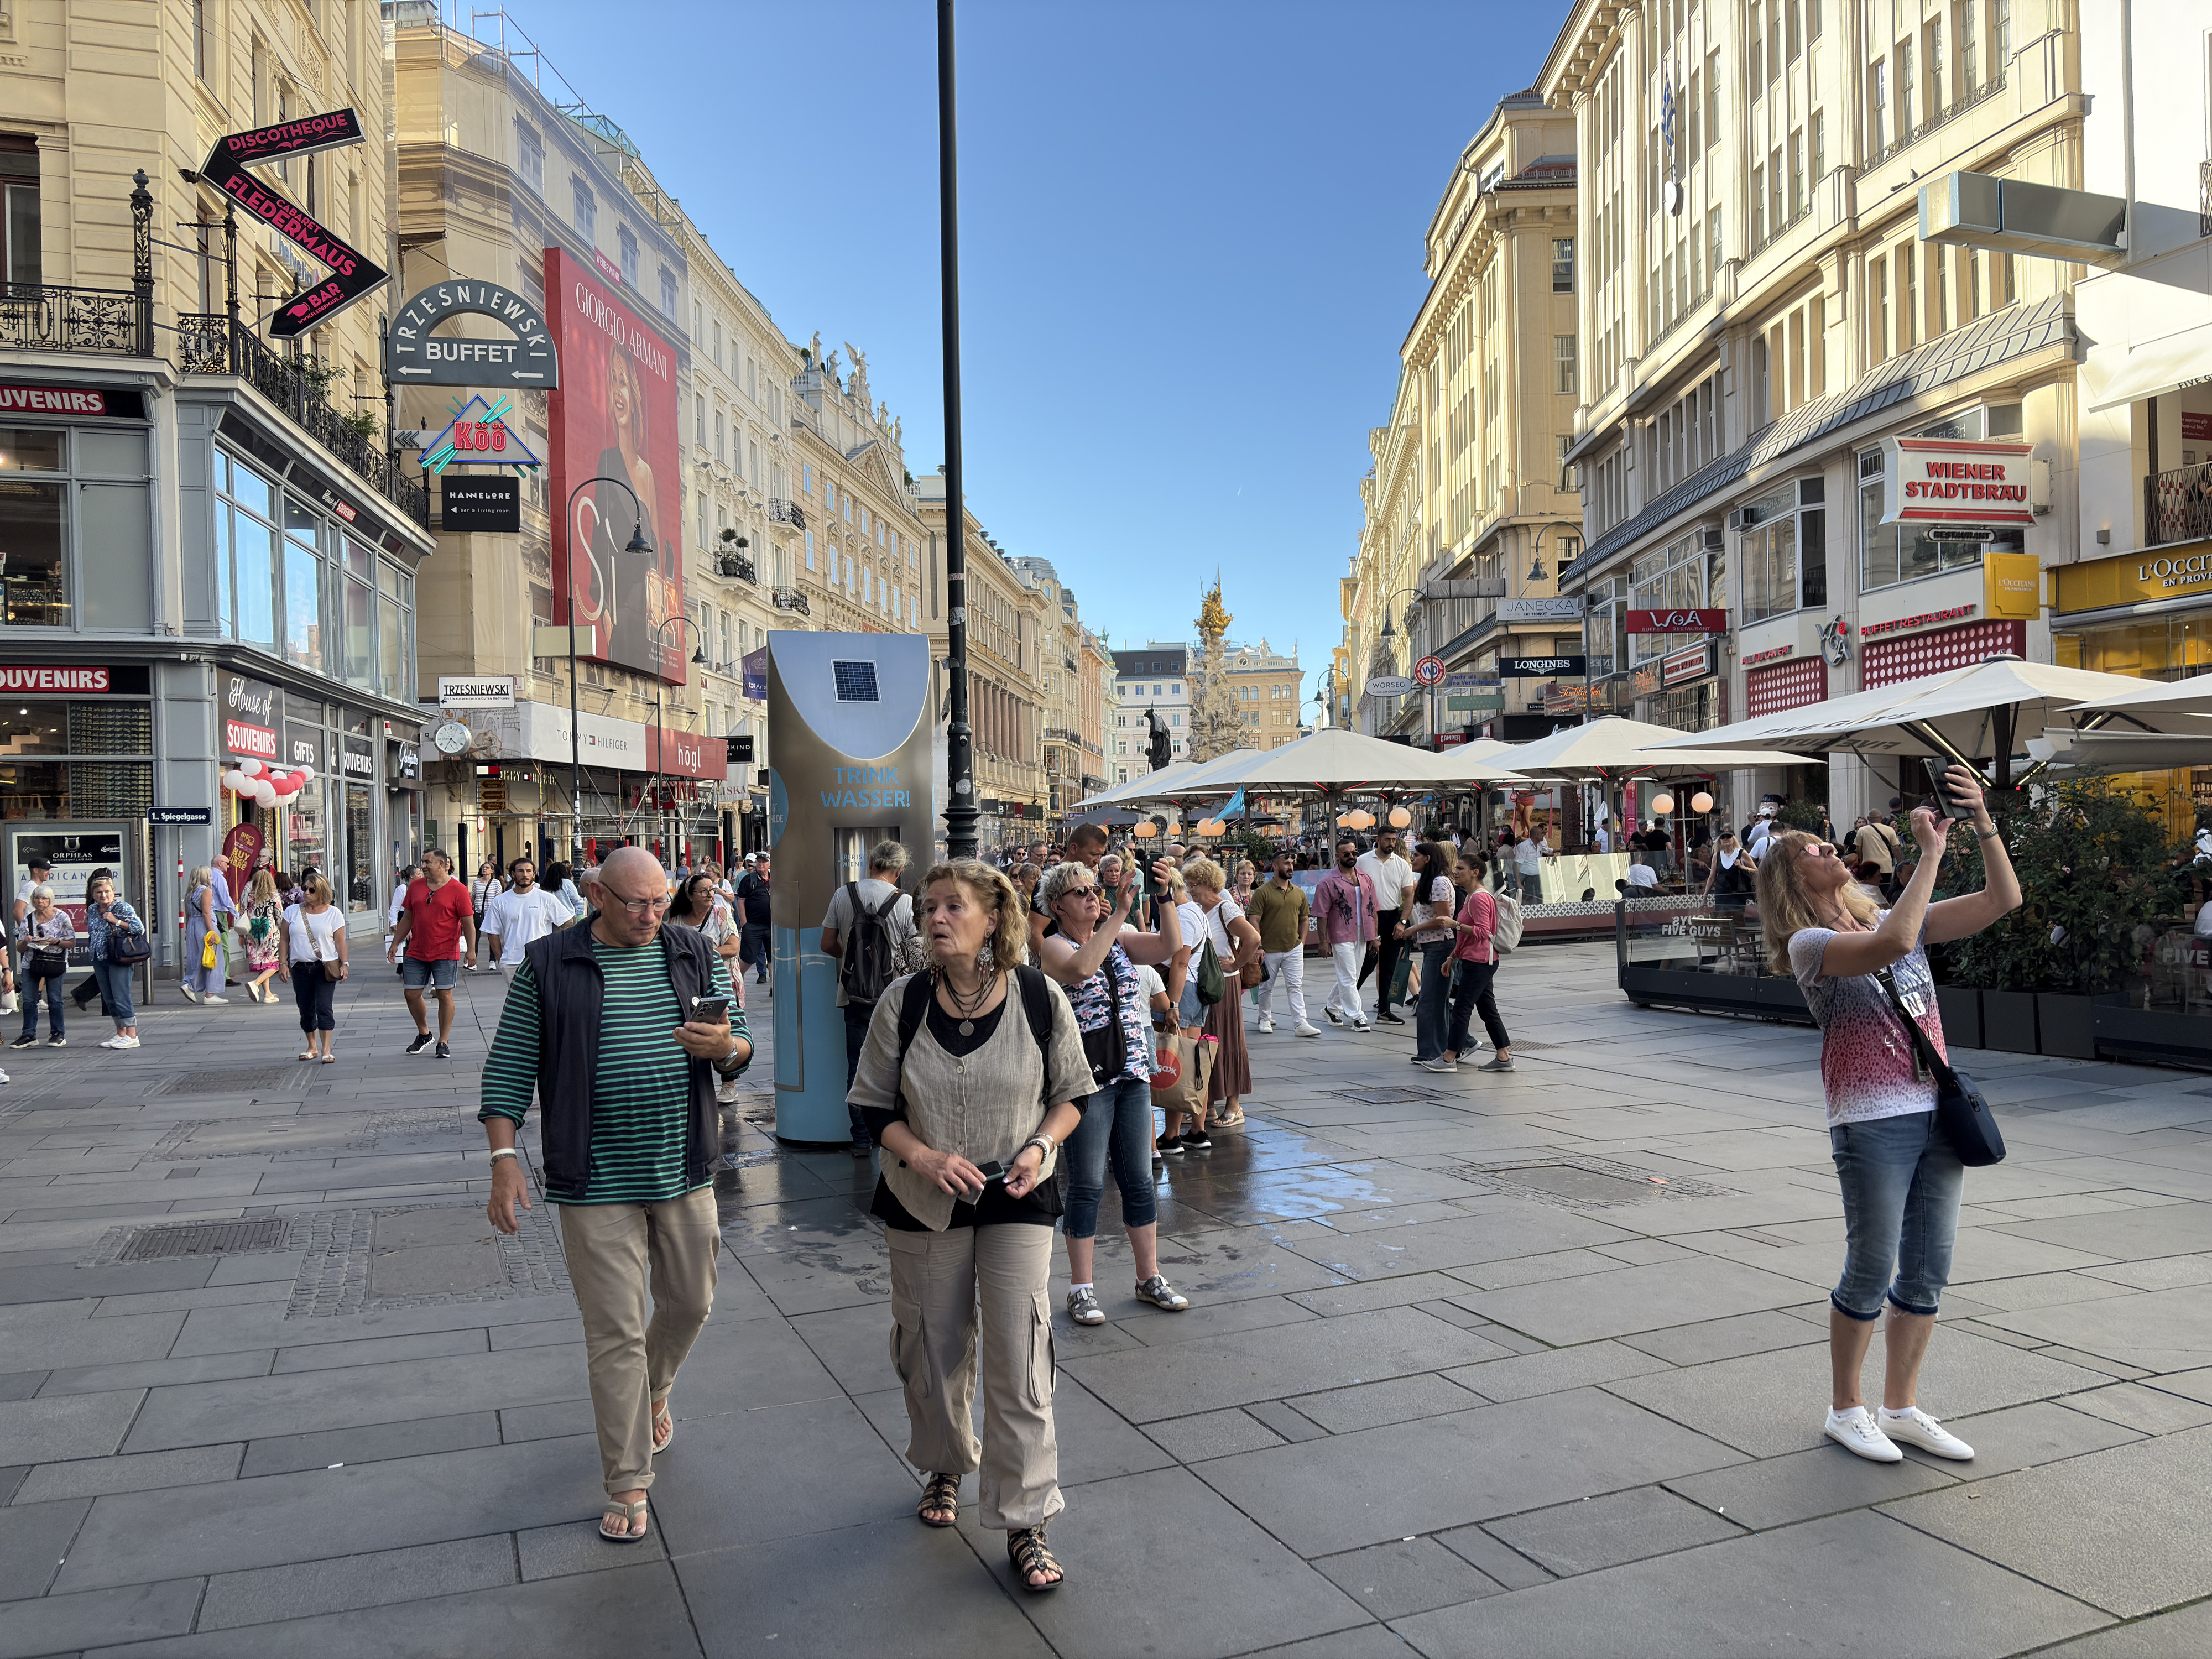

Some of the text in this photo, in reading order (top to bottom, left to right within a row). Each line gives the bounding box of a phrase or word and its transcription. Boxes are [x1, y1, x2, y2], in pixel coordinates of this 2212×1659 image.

[228, 113, 348, 151] DISCOTHEQUE
[224, 175, 357, 276] FLEDERMAUS
[276, 199, 322, 233] CABARET
[596, 252, 620, 281] WERBEWAND
[307, 283, 341, 307] BAR
[298, 293, 345, 324] WWW.FLEDERMAUS.AT
[397, 285, 547, 357] TRZEŚNIEWSKI
[576, 282, 667, 382] GIORGIO ARMANI
[426, 342, 517, 363] BUFFET
[2178, 377, 2201, 389] FIVE
[1927, 461, 2006, 481] WIENER
[1906, 481, 2027, 502] STADTBRÄU
[1999, 578, 2036, 588] L'OCCITANE
[2163, 578, 2176, 587] EN
[1507, 599, 1574, 612] JANECKA
[1860, 604, 1975, 636] BUFFET RESTAURANT
[1742, 644, 1790, 665] ALL YOU CAN EAT
[1514, 660, 1571, 669] LONGINES
[1665, 664, 1680, 675] WIENER
[444, 684, 509, 695] TRZEŚNIEWSKI
[229, 677, 272, 726] House of
[227, 723, 275, 755] SOUVENIRS
[598, 737, 628, 752] HILFIGER
[294, 740, 314, 764] GIFTS
[331, 747, 336, 766] &
[833, 766, 899, 785] TRINK
[821, 790, 910, 808] WASSER!
[161, 812, 206, 822] Spiegelgasse
[241, 831, 249, 839] BIG
[232, 847, 251, 861] BUY
[228, 858, 247, 871] HERE
[1662, 925, 1721, 937] FIVE GUYS
[2163, 948, 2209, 965] FIVE
